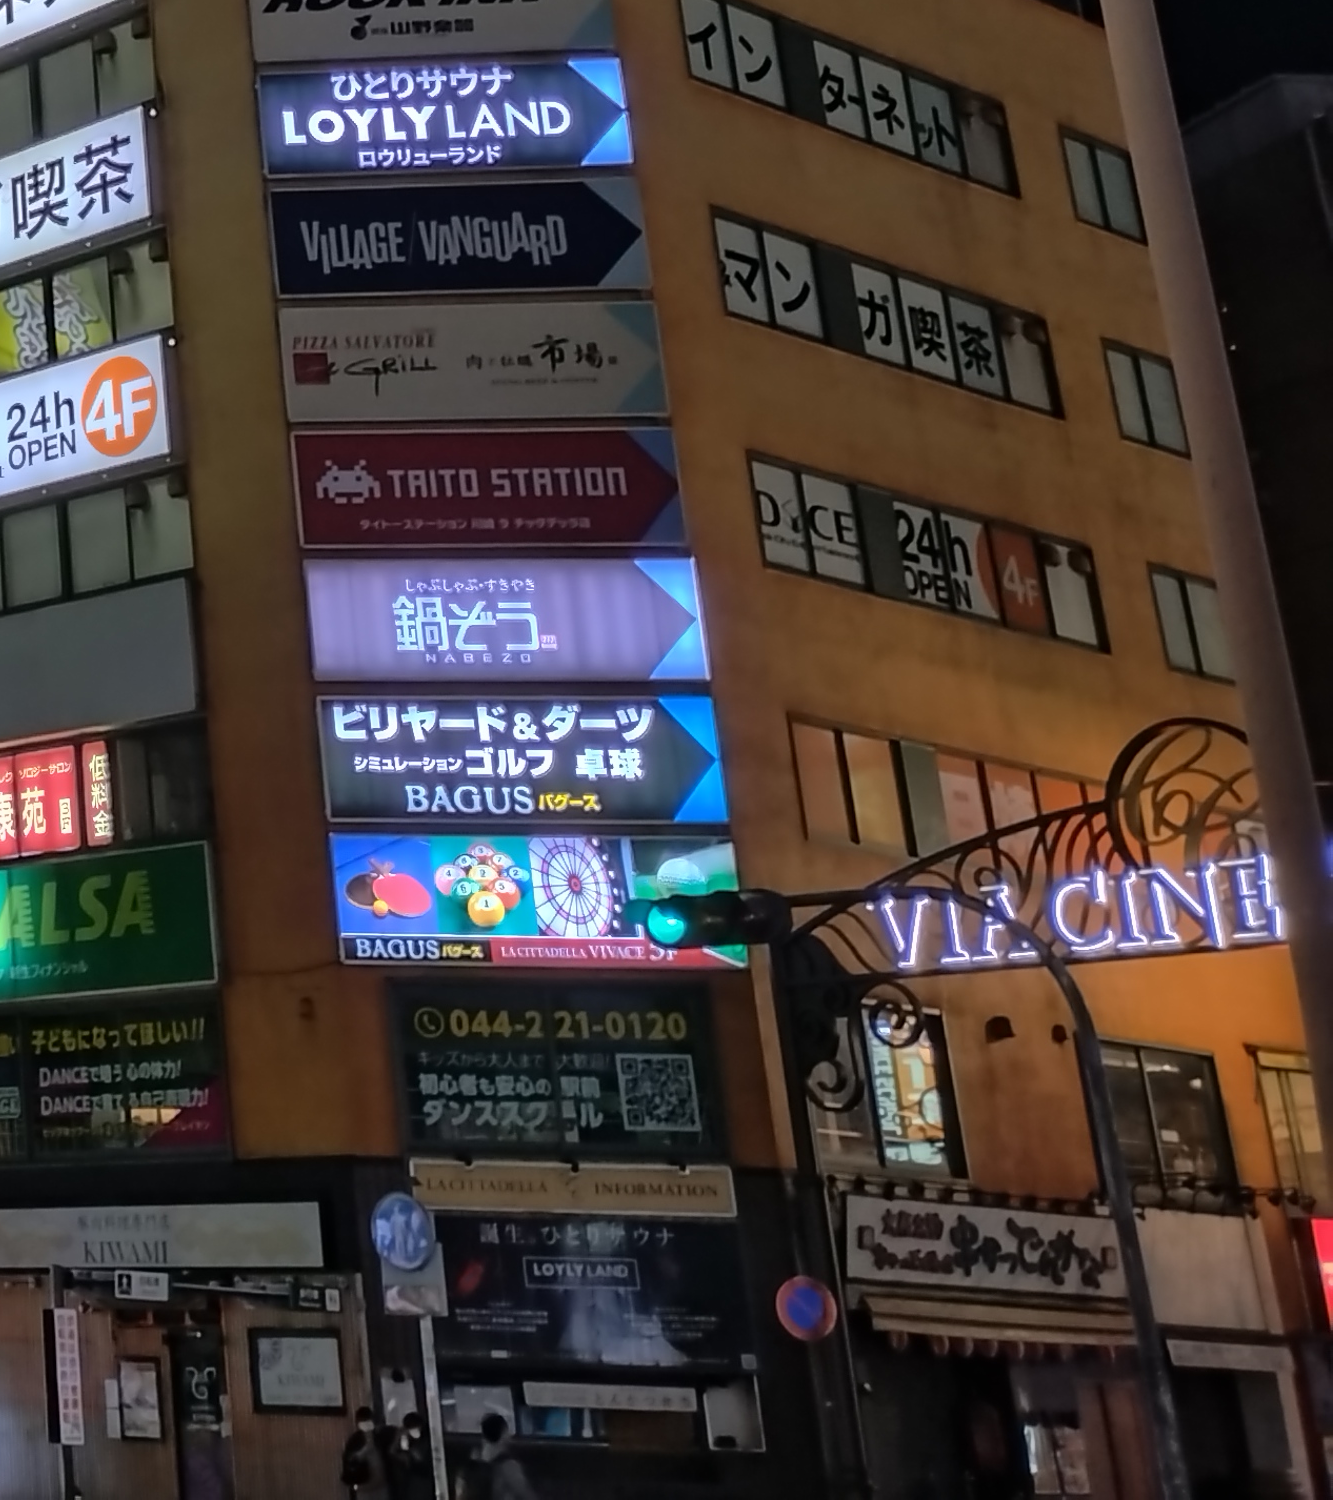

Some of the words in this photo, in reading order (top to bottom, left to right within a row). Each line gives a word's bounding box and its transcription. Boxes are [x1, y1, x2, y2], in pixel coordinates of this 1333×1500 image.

[330, 66, 514, 101] ひとりサウナ
[280, 104, 439, 145] LOYLY
[444, 99, 574, 140] LAND
[356, 144, 504, 169] ロウリューランド
[299, 219, 407, 275] VILLAGE
[418, 211, 569, 267] VANGUARD
[291, 335, 339, 351] PIZZA
[6, 389, 76, 446] 24h
[81, 375, 153, 443] 4F
[7, 427, 79, 472] OPEN
[386, 467, 480, 499] TAITO
[490, 466, 629, 498] STATION
[894, 508, 972, 579] 24h
[392, 595, 541, 652] 鍋ぞう
[425, 652, 533, 664] NABEZO
[332, 703, 654, 743] ビリヤード&ダーツ
[574, 748, 645, 780] 卓球
[404, 785, 535, 815] BAGUS
[537, 793, 603, 813] バグース
[1050, 851, 1288, 952] CINE
[355, 939, 441, 960] BAGUS
[593, 1180, 720, 1198] INFORMATION
[82, 1240, 169, 1265] KIWAMI
[532, 1261, 584, 1278] LOYLY
[586, 1262, 629, 1278] LAND
